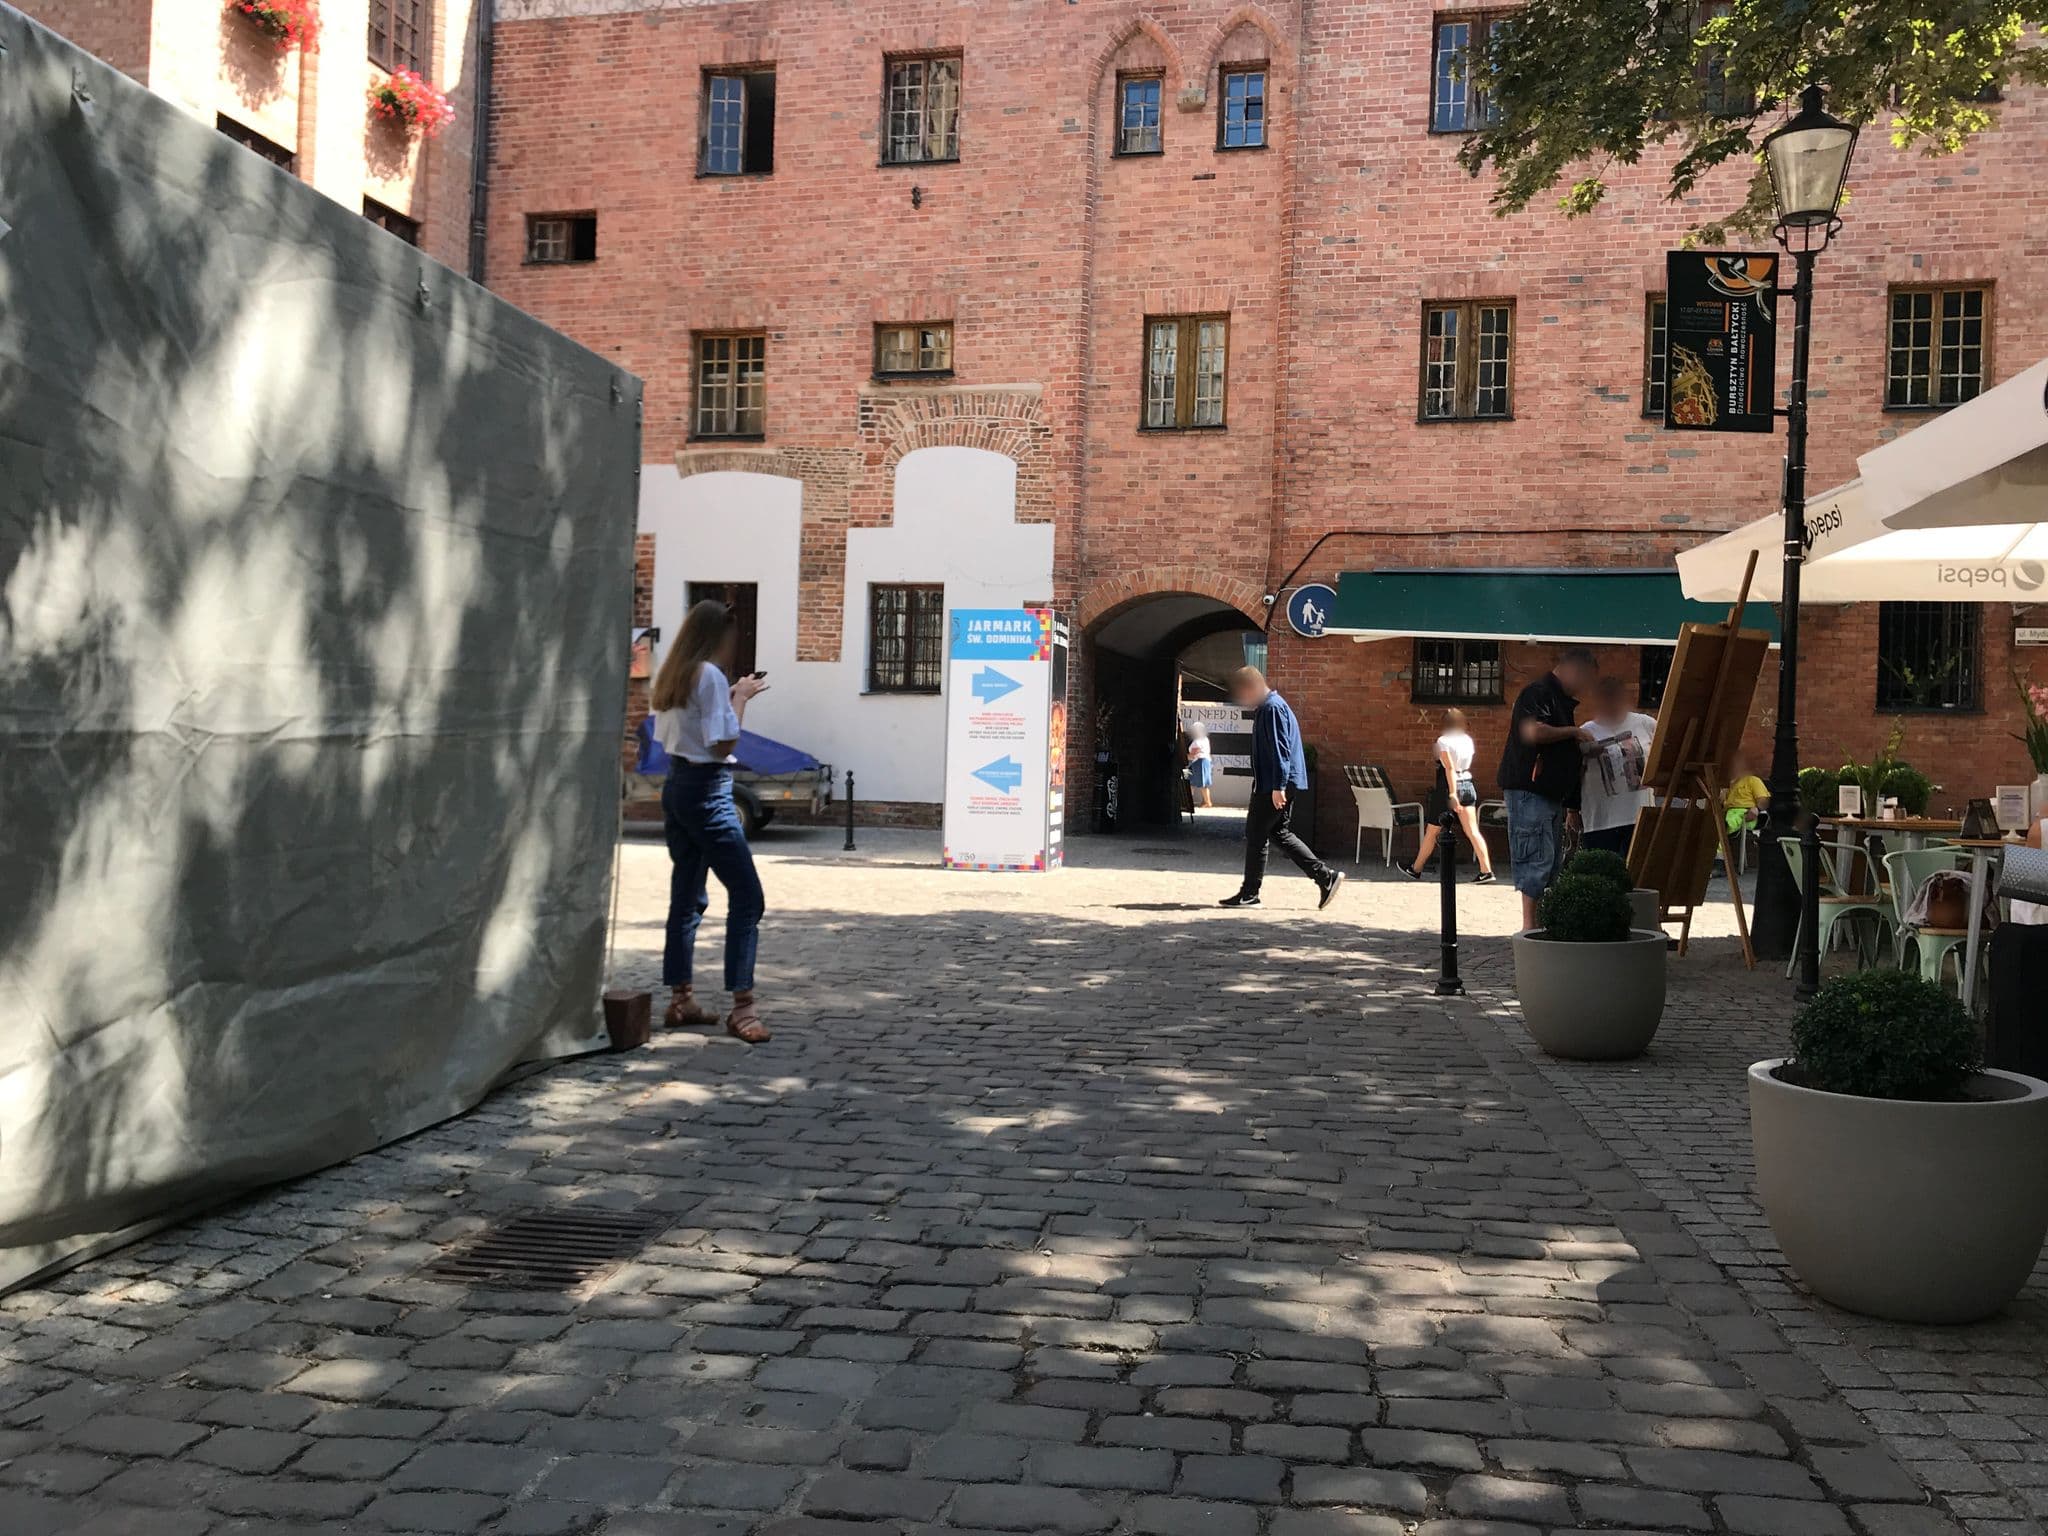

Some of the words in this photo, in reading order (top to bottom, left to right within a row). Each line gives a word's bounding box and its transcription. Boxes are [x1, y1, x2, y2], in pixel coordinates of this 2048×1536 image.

[1731, 302, 1740, 354] BAŁTYCKI
[1729, 357, 1738, 414] BURSZTYN
[1736, 366, 1745, 415] Dziedzictwo
[1810, 504, 1842, 542] pepsi
[968, 620, 1032, 632] JARMARK
[986, 634, 1032, 644] DOMINIKA
[1198, 709, 1226, 720] NEED
[1230, 709, 1239, 720] IS
